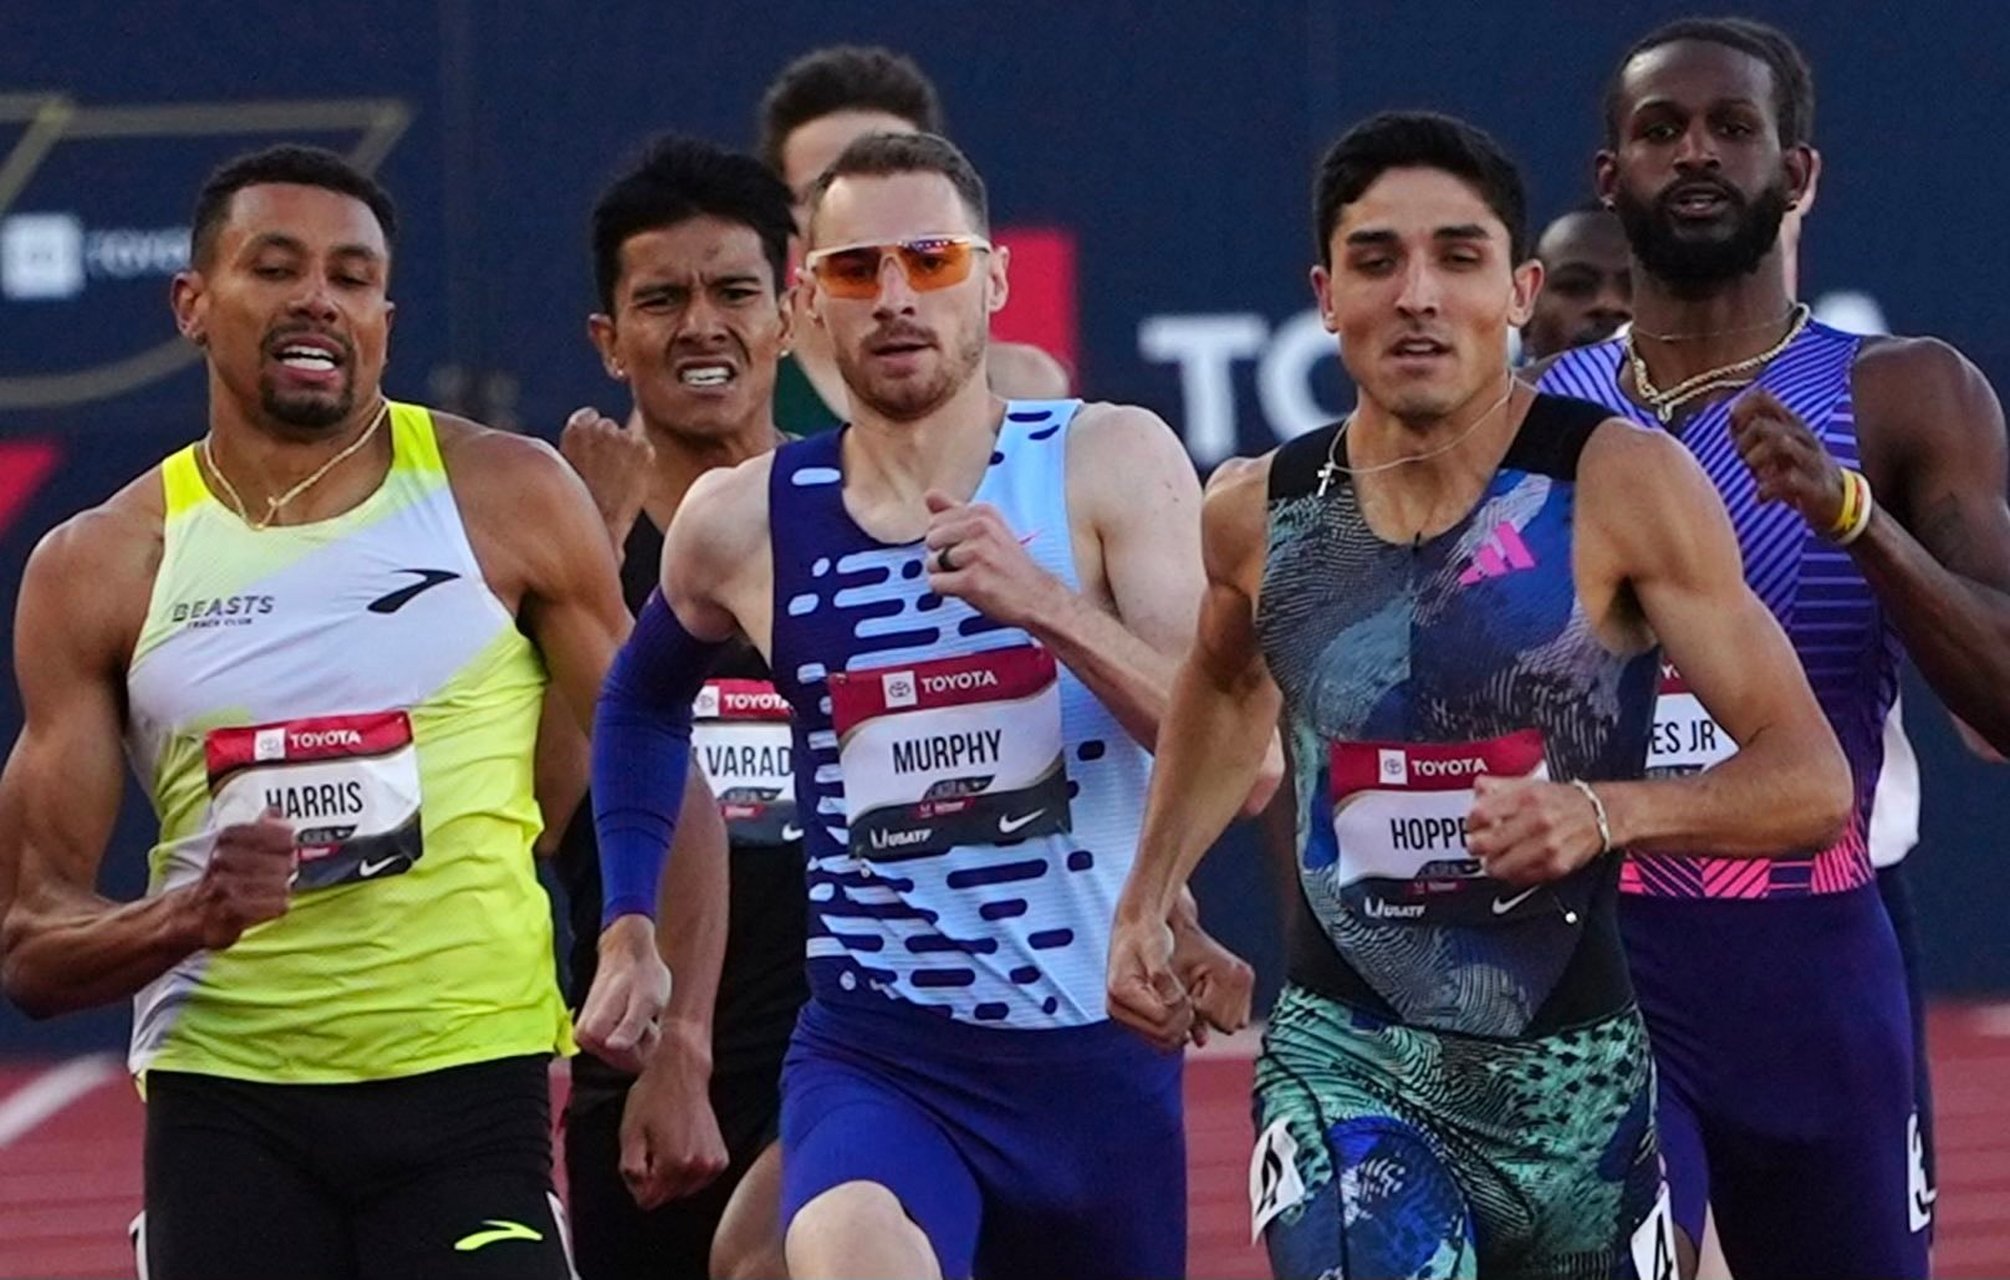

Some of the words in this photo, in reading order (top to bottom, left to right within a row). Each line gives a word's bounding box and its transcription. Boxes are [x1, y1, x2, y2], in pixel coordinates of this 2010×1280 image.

[172, 595, 275, 622] BEASTS
[923, 670, 998, 694] TOYOTA
[290, 730, 362, 749] TOYOTA
[1689, 719, 1716, 752] JR
[693, 746, 793, 777] VARAD
[892, 728, 1002, 774] MURPHY
[1411, 757, 1488, 777] TOYOTA
[266, 781, 363, 819] HARRIS
